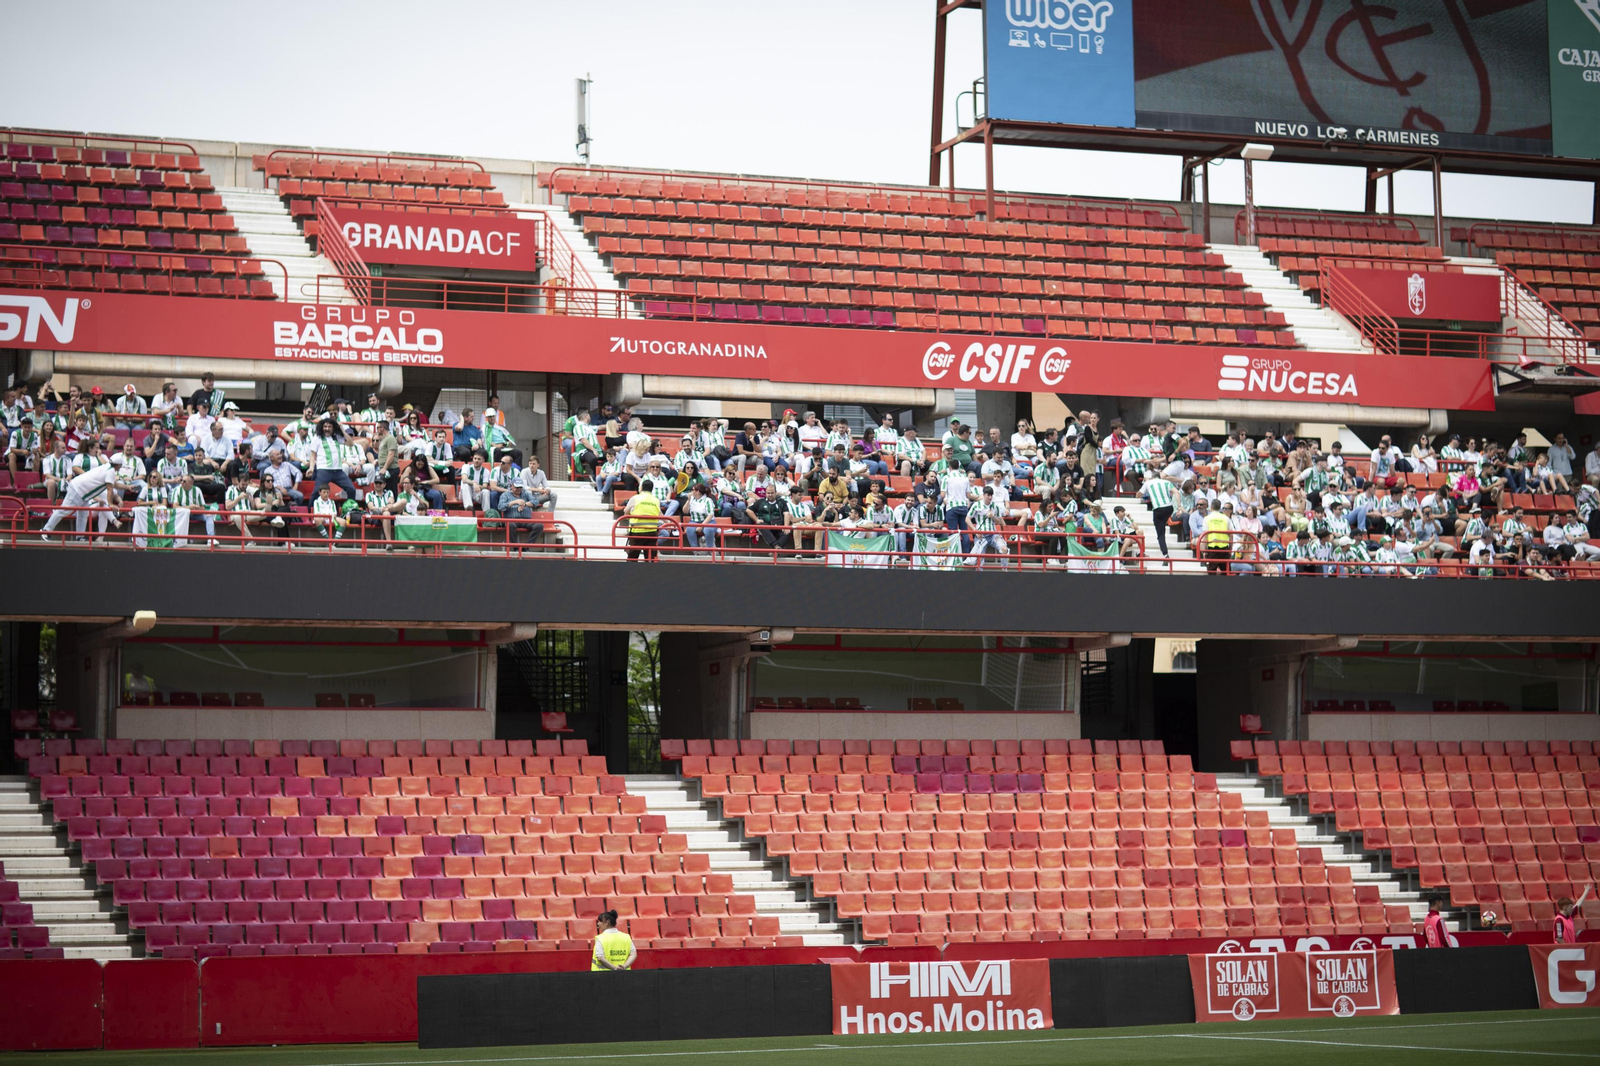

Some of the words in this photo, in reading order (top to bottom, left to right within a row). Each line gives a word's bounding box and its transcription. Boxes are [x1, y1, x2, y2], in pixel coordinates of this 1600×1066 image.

[1006, 0, 1113, 33] wiber
[1558, 47, 1600, 67] CAJA
[1254, 121, 1309, 137] NUEVO
[301, 305, 415, 325] GRUPO
[273, 321, 444, 353] BARCALO
[274, 347, 358, 361] ESTACIONES
[361, 350, 380, 362] DE
[383, 352, 444, 365] SERVICIO
[609, 336, 768, 359] AUTOGRANADINA
[959, 342, 1036, 384] CSIF
[1251, 358, 1292, 371] GRUPO
[1248, 369, 1358, 396] NUCESA
[1547, 948, 1596, 1004] G
[1217, 983, 1230, 997] DE
[1232, 982, 1269, 996] CABRAS
[1317, 981, 1329, 994] DE
[1332, 980, 1369, 994] CABRAS
